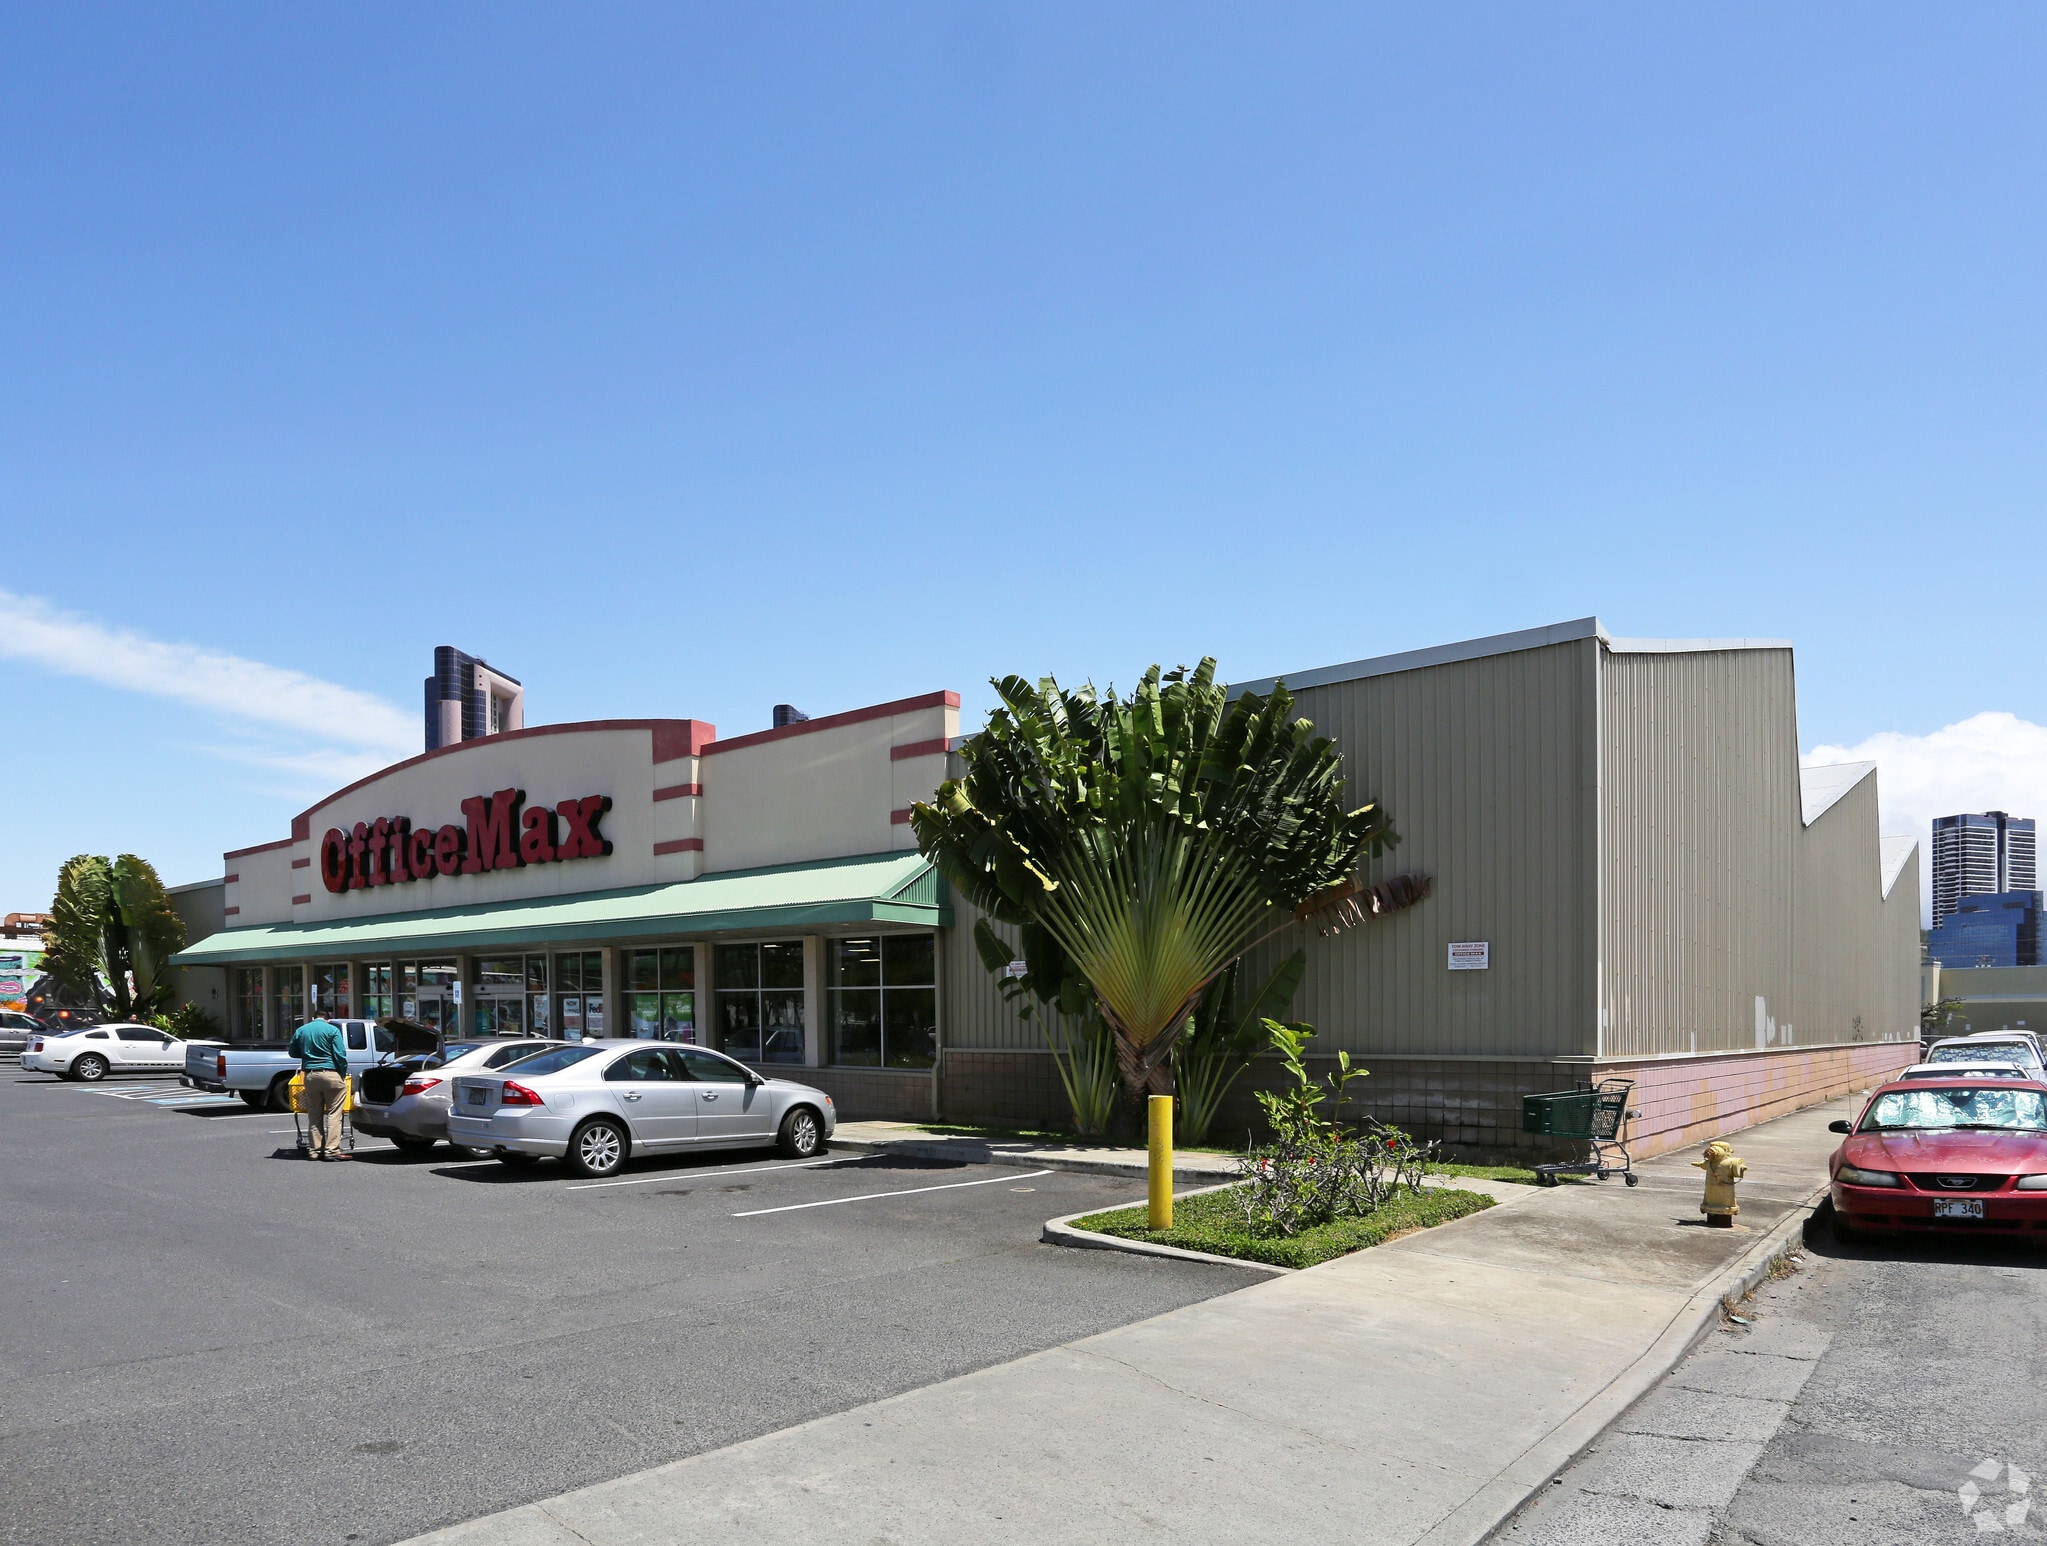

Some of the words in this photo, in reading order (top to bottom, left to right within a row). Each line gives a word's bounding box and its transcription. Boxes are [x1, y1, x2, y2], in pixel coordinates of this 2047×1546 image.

[321, 788, 613, 893] OfficeMax
[589, 1003, 604, 1013] FedE
[1935, 1202, 1954, 1214] RPF
[1961, 1203, 1981, 1214] 340
